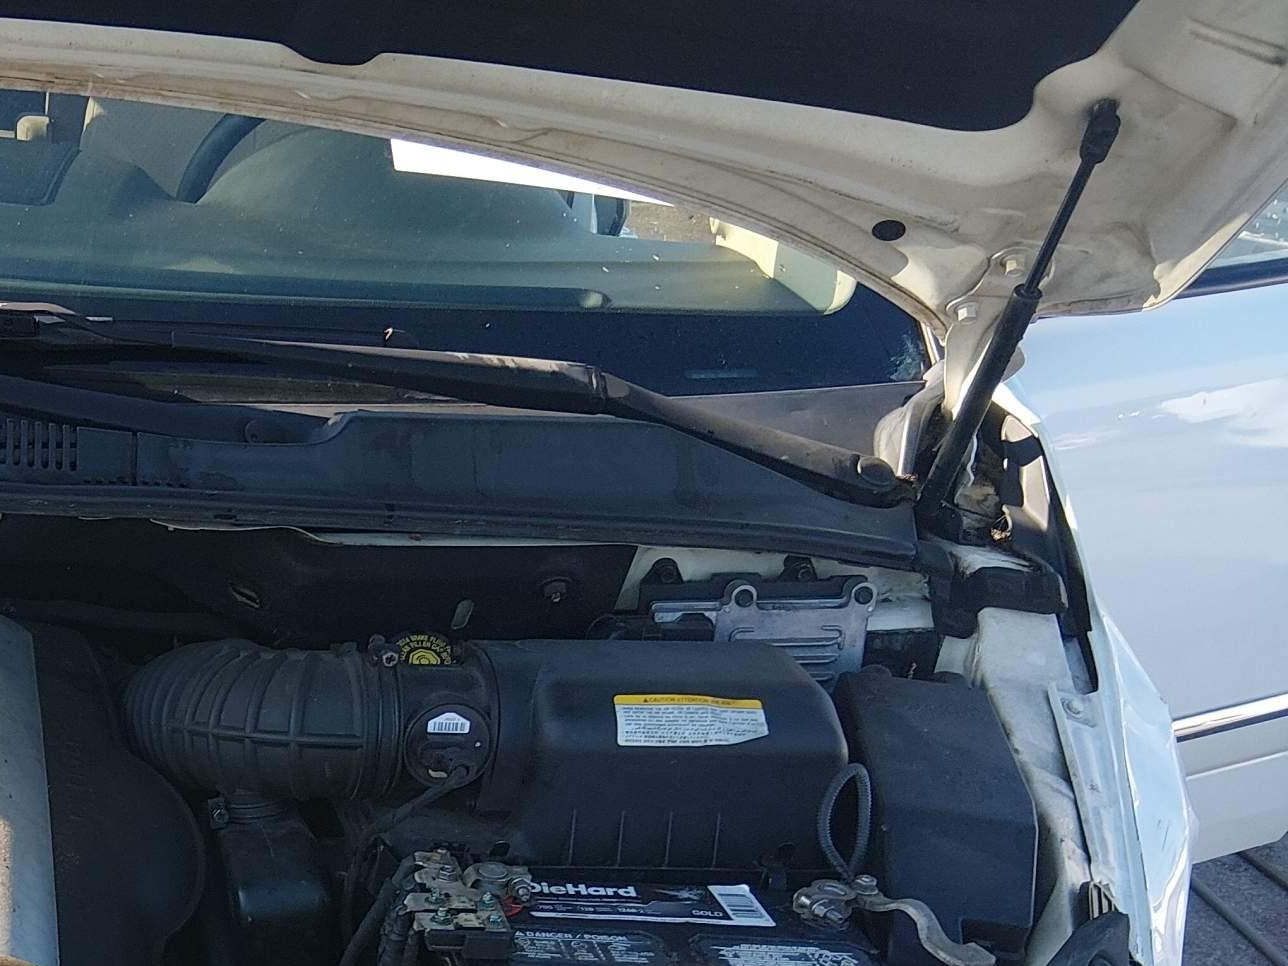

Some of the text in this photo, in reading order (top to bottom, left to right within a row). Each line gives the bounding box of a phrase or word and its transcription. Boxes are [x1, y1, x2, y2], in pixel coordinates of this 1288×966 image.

[692, 909, 724, 917] GOLD
[526, 931, 572, 939] DANGER
[584, 934, 628, 942] POISON
